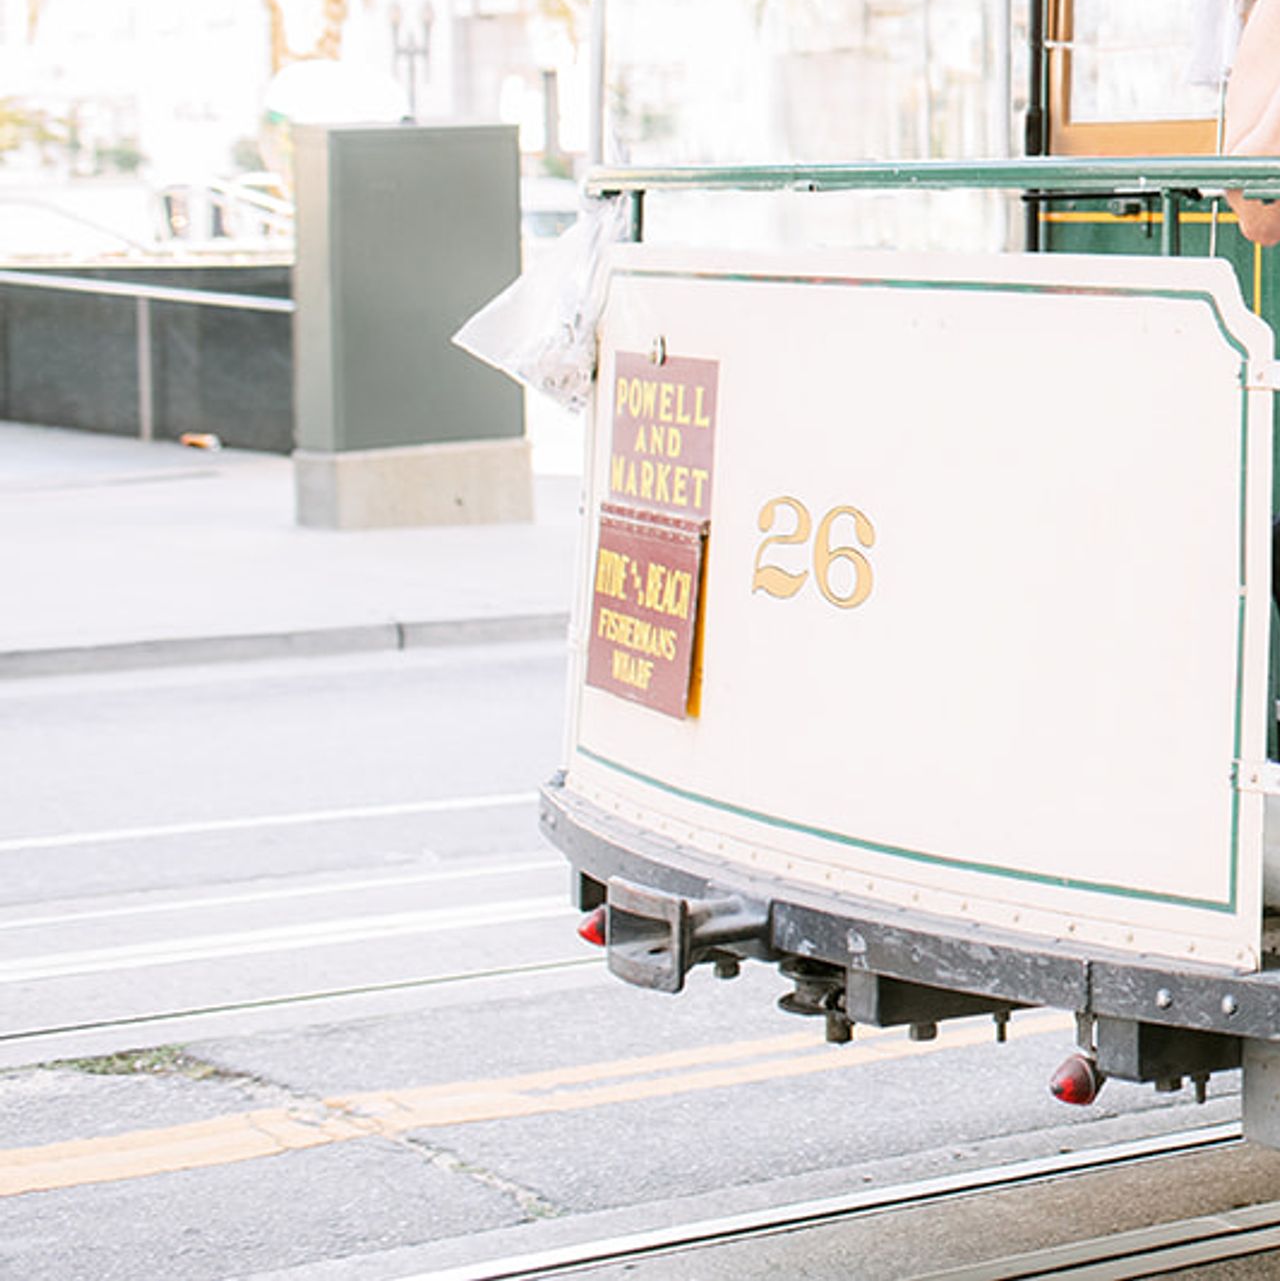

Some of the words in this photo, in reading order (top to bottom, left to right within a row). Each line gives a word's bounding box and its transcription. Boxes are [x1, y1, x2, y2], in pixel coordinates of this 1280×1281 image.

[615, 376, 712, 429] POWELL
[633, 425, 683, 459] AND
[610, 453, 709, 510] MARKET
[751, 494, 877, 610] 26
[645, 562, 693, 620] BEACH
